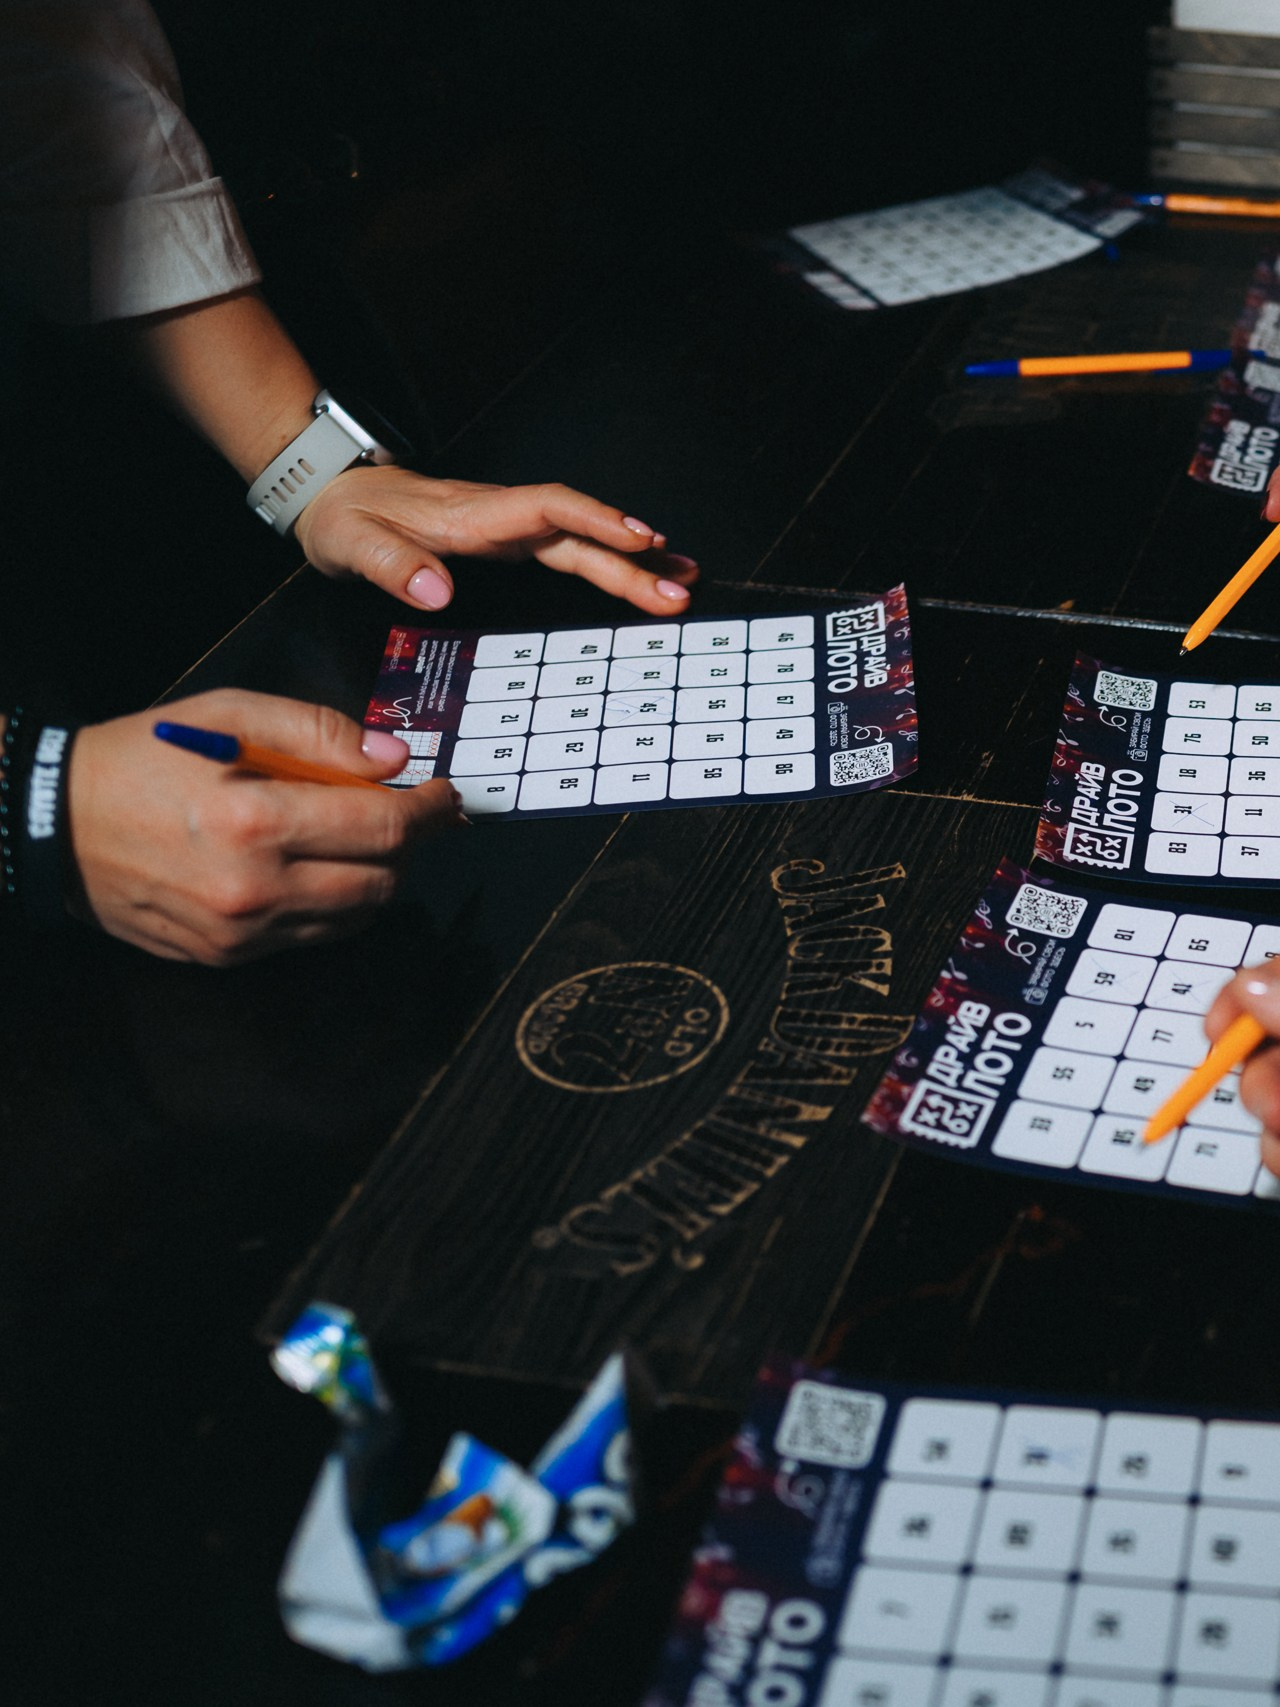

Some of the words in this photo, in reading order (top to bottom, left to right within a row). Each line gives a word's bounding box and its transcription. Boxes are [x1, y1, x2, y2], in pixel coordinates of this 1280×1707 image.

[1244, 426, 1280, 468] ЛОТО
[712, 636, 730, 647] 28
[777, 632, 794, 643] 46
[513, 649, 532, 659] 54
[580, 644, 598, 655] 40
[777, 663, 795, 673] 78
[826, 641, 858, 694] ЛОТО
[860, 636, 891, 688] ДРАЙВ
[643, 671, 661, 680] 61
[710, 668, 728, 677] 23
[507, 681, 526, 691] 81
[575, 675, 594, 686] 63
[708, 699, 726, 710] 56
[776, 695, 794, 705] 67
[1188, 699, 1206, 709] 53
[570, 707, 589, 719] 30
[639, 702, 658, 713] 45
[1254, 702, 1272, 712] 65
[500, 714, 520, 724] 21
[828, 714, 838, 729] ФОТО
[706, 733, 725, 743] 16
[775, 728, 794, 740] 49
[1128, 725, 1142, 749] ЗАБИРАЙ
[1183, 733, 1202, 744] 76
[635, 736, 654, 747] 32
[1140, 734, 1151, 749] ФОТО
[1251, 735, 1269, 746] 50
[493, 747, 513, 759] 65
[565, 741, 584, 753] 62
[703, 767, 723, 779] 58
[775, 763, 794, 775] 86
[1178, 768, 1197, 779] 18
[631, 773, 651, 783] 11
[1247, 770, 1266, 781] 36
[559, 777, 579, 790] 85
[1070, 761, 1106, 827] ДРАЙВ
[1103, 768, 1144, 832] ЛОТО
[1173, 805, 1193, 815] 31
[1244, 808, 1263, 817] 11
[1168, 841, 1188, 854] 83
[1240, 845, 1260, 857] 37
[770, 859, 907, 1000] JACK
[1075, 1021, 1094, 1029] 5
[1094, 971, 1116, 986] 59
[1113, 928, 1135, 941] 81
[1151, 1029, 1173, 1043] 77
[1171, 983, 1193, 995] 41
[1188, 938, 1210, 952] 65
[527, 983, 590, 1054] BRAND
[664, 1007, 711, 1057] OLD
[925, 1000, 991, 1087] ДРАЙВ
[962, 1012, 1033, 1099] ЛОТО
[534, 1005, 915, 1278] DANIEL'S
[686, 1588, 769, 1707] РАЙВ
[746, 1598, 827, 1707] ОТО
